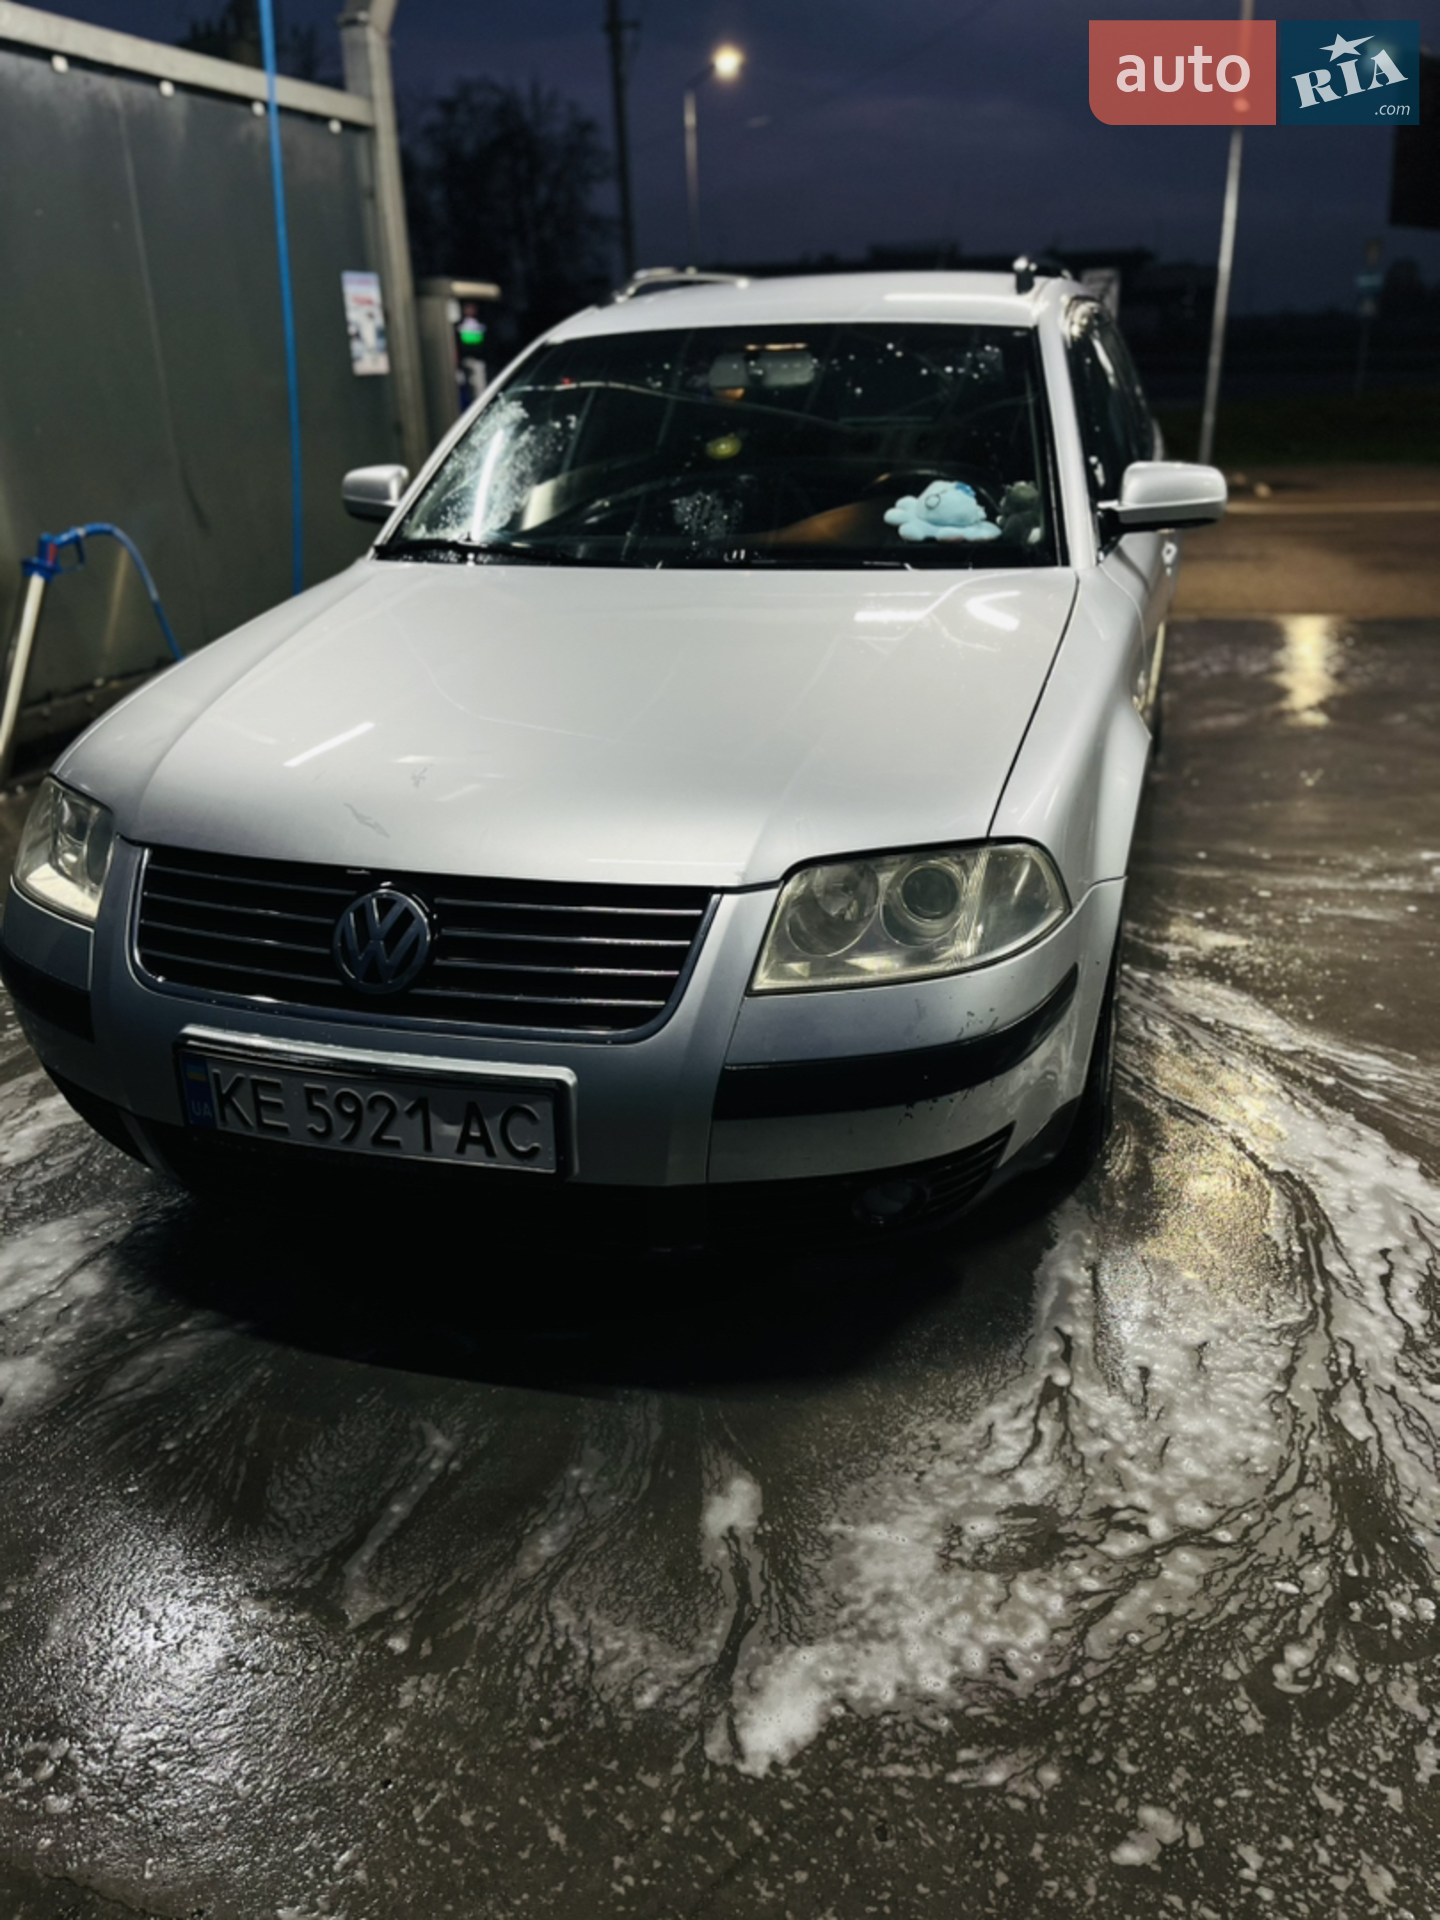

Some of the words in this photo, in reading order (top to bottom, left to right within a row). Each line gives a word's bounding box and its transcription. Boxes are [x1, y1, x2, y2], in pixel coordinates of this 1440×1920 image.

[190, 1099, 214, 1119] UA
[212, 1069, 290, 1134] KE
[303, 1083, 434, 1153] 5921
[455, 1100, 541, 1160] AC
